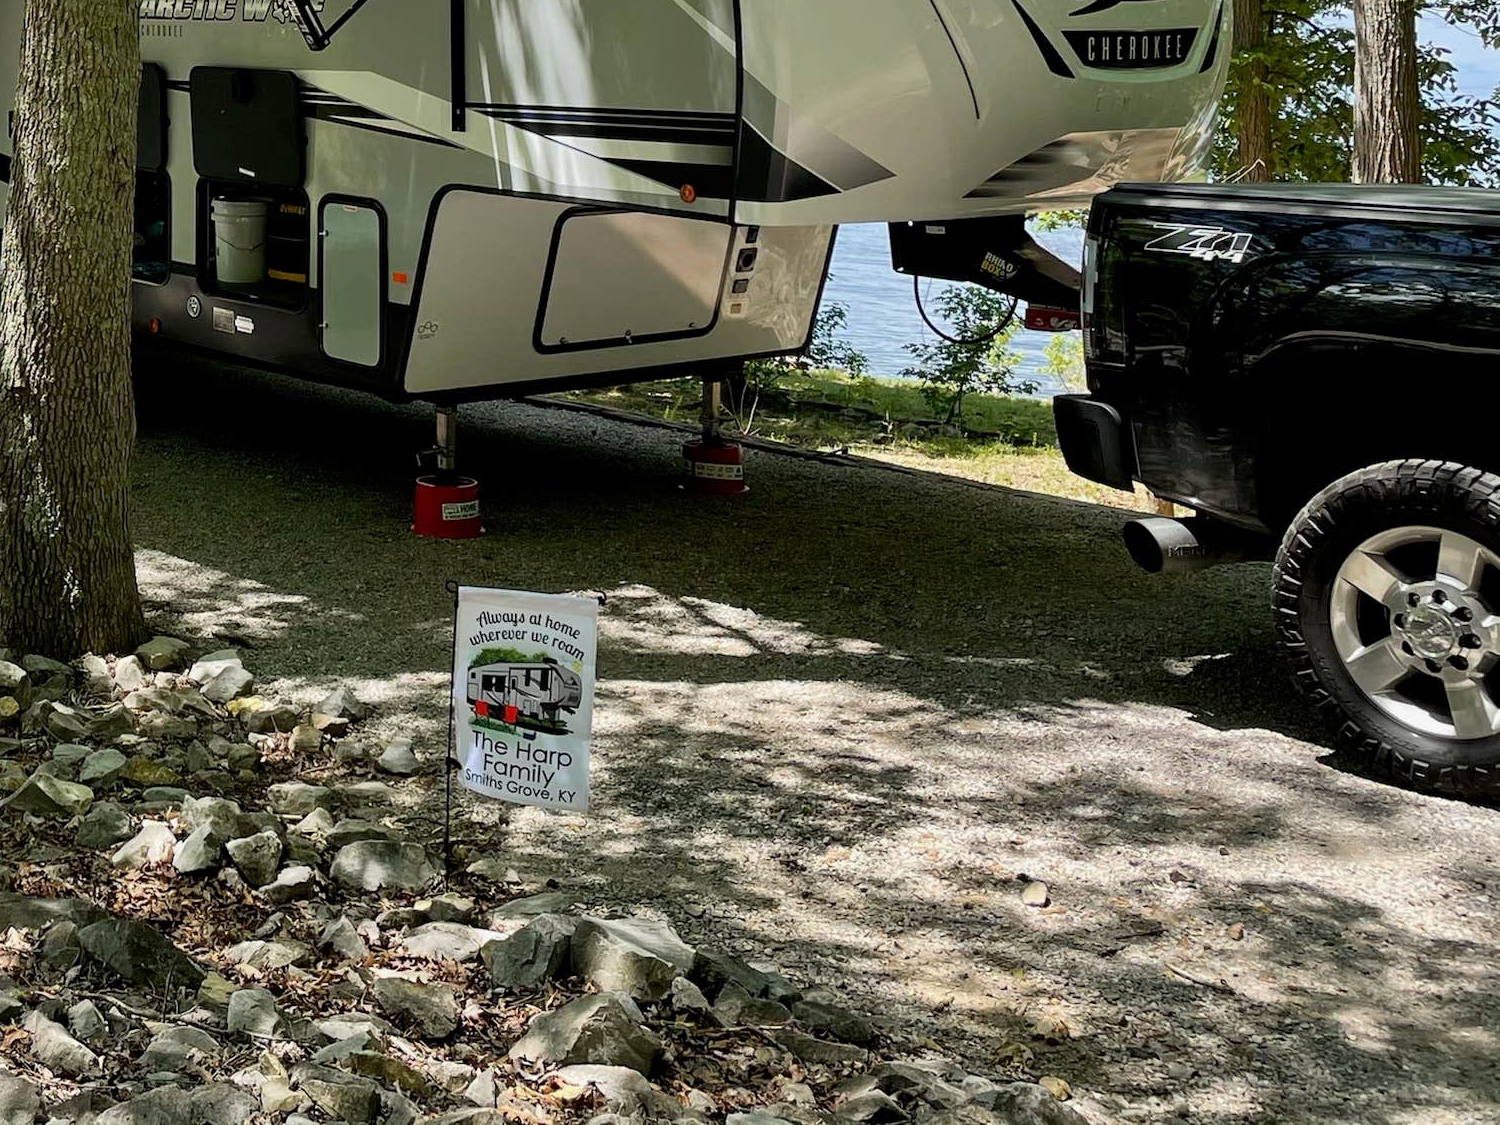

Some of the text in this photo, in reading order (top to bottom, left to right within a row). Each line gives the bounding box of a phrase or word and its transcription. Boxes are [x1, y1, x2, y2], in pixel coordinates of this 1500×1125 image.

[1087, 33, 1183, 61] CHEROKEE
[1144, 222, 1253, 254] Z71
[476, 611, 581, 640] Always at home
[469, 629, 585, 661] wherever we roam
[472, 730, 573, 770] The Harp
[465, 768, 577, 803] Smiths Grove, KY
[483, 753, 555, 789] Family
